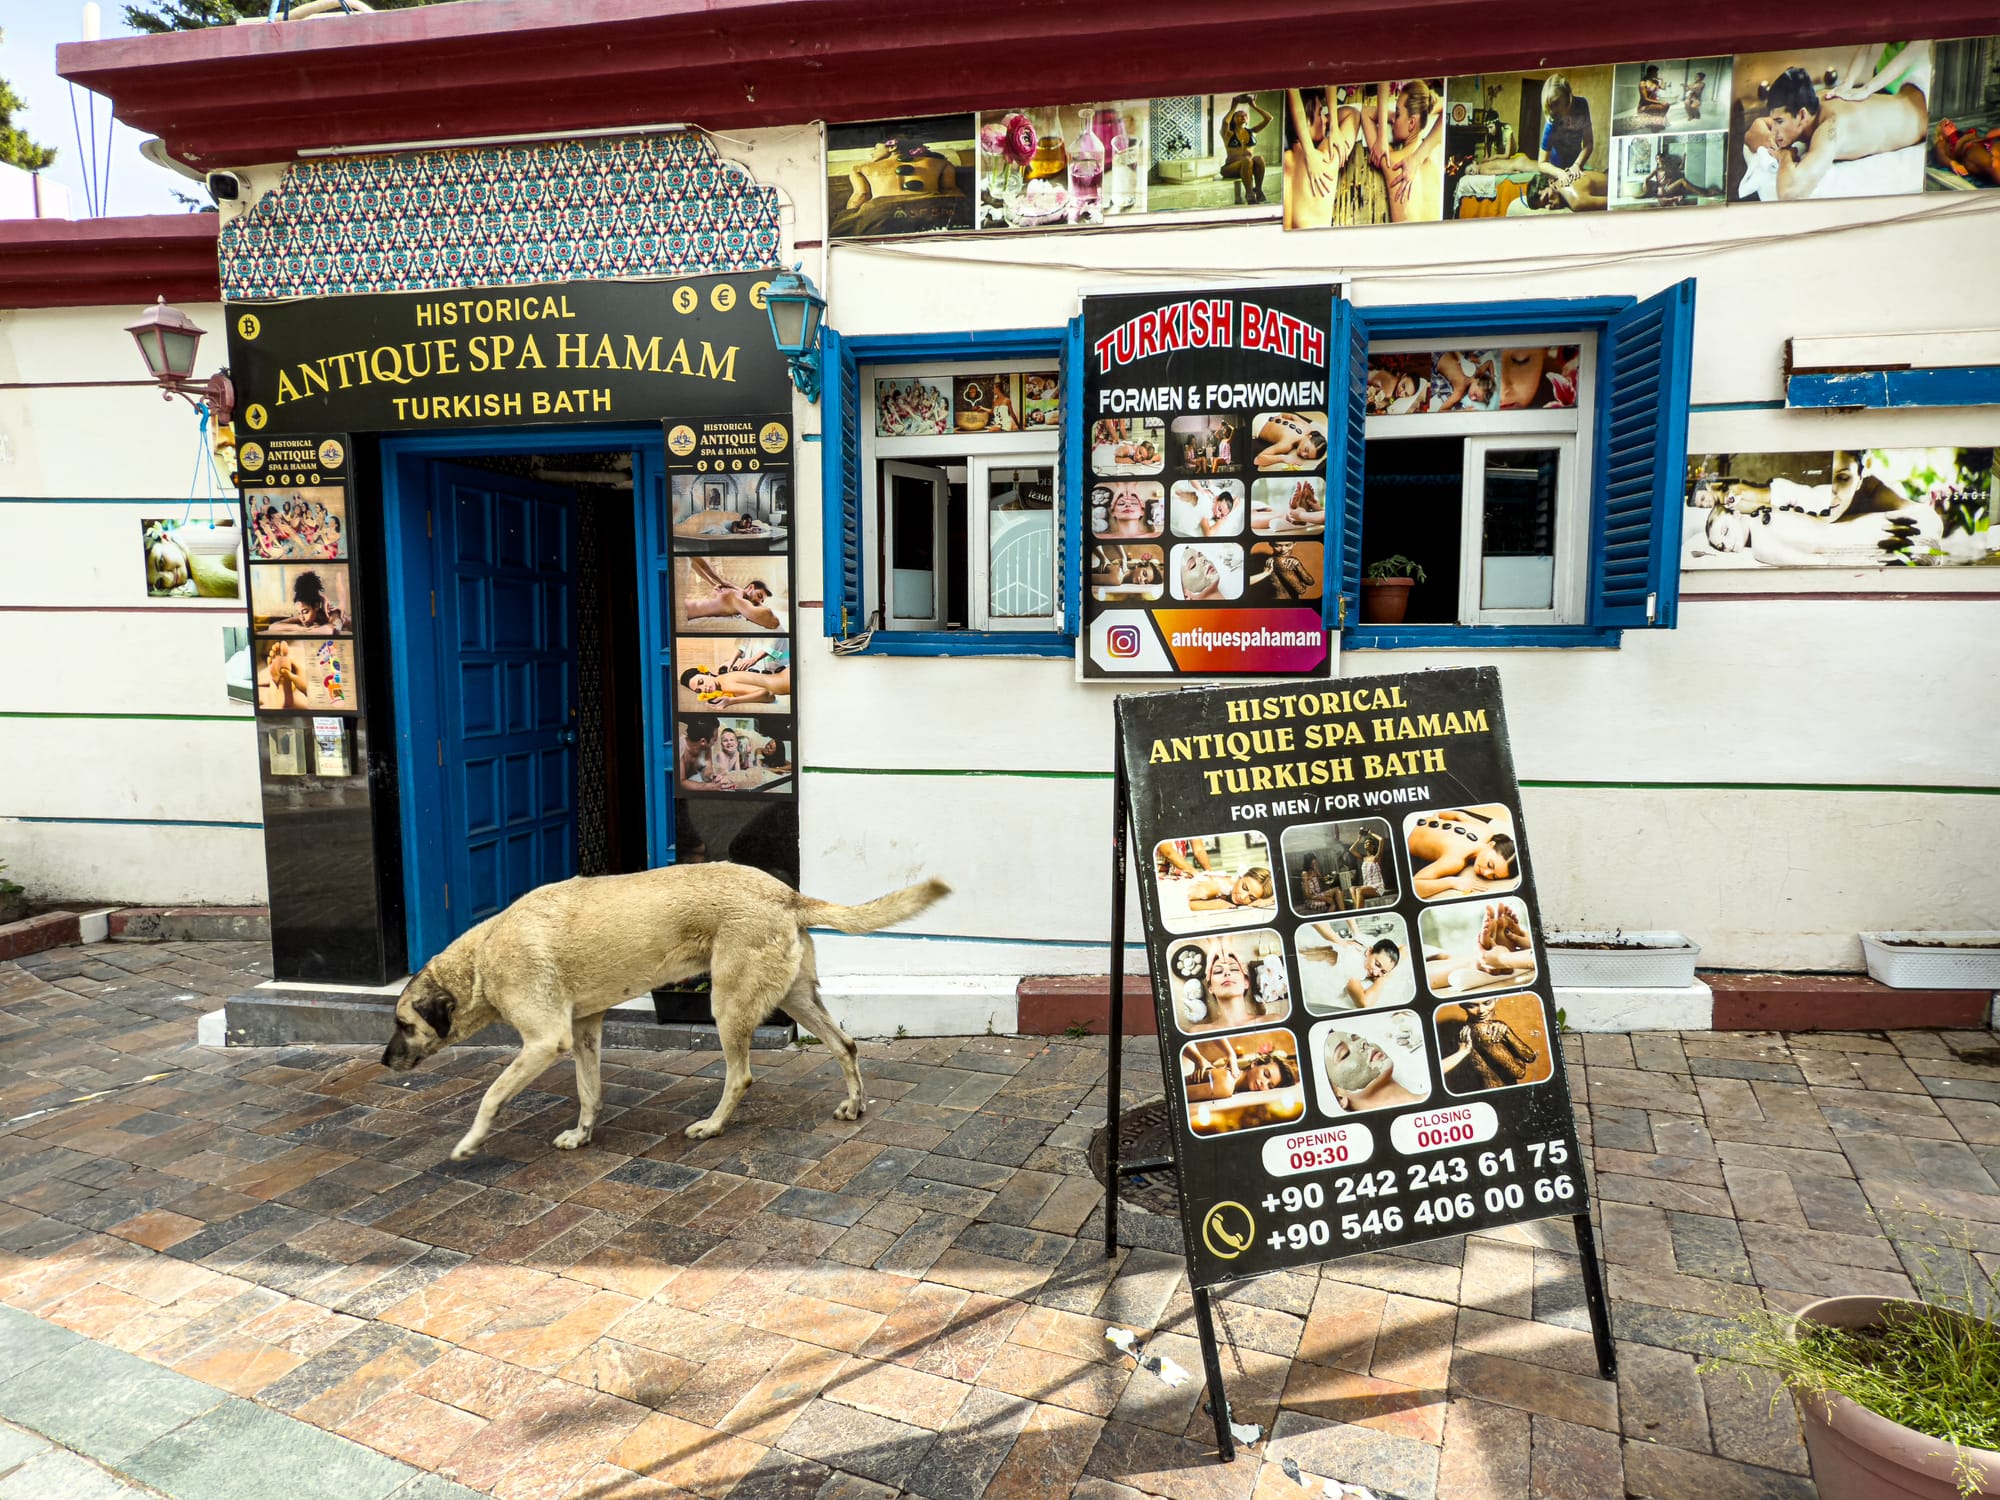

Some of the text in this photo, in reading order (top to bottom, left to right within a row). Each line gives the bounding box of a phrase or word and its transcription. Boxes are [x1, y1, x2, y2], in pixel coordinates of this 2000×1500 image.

[416, 296, 575, 326] HISTORICAL
[1094, 299, 1325, 375] TURKISH BATH
[275, 333, 740, 406] ANTIQUE SPA HAMAM
[392, 388, 612, 421] TURKISH BATH
[1099, 380, 1325, 413] FORMEN & FORWOMEN
[700, 434, 756, 446] ANTIQUE
[703, 422, 752, 431] HISTORICAL
[267, 450, 316, 462] ANTIQUE
[270, 440, 312, 448] HISTORICAL
[726, 447, 757, 455] HAMAM
[290, 462, 317, 470] HAMAM
[1171, 627, 1321, 652] antiquespahamam
[1226, 686, 1407, 723] HISTORICAL
[1149, 709, 1490, 764] ANTIQUE SPA HAMAM
[1203, 748, 1447, 795] TURKISH BATH
[1230, 785, 1430, 821] FOR MEN / FOR WOMEN
[1413, 1109, 1472, 1129] CLOSING
[1286, 1129, 1348, 1150] OPENING
[1417, 1123, 1475, 1148] 00:00
[1289, 1145, 1349, 1170] 09:30
[1261, 1139, 1568, 1214] +90 242 243 61 75
[1266, 1174, 1575, 1251] +90 546 406 00 66
